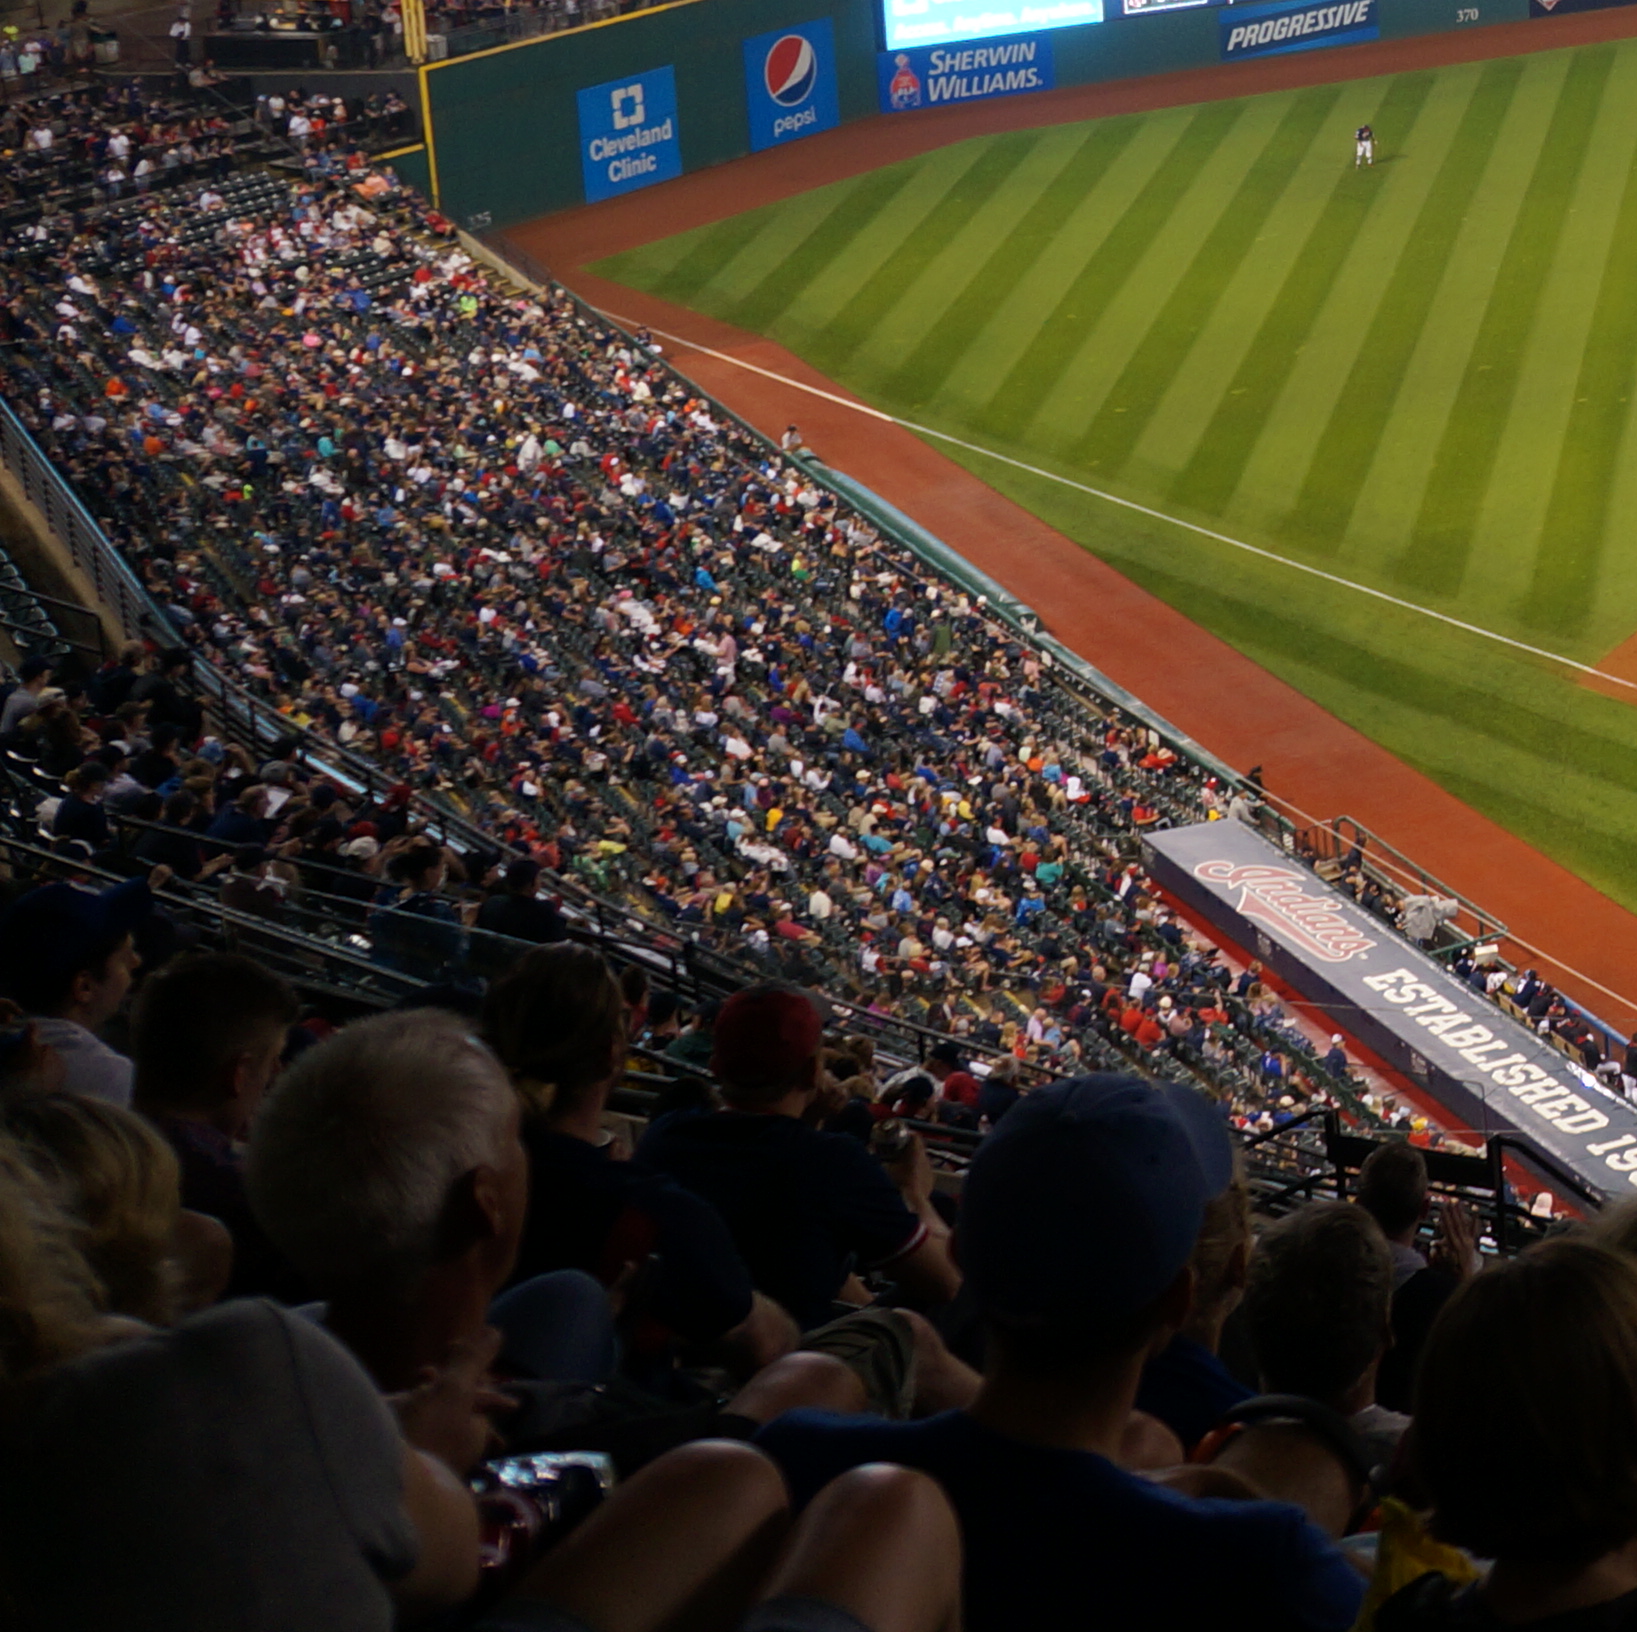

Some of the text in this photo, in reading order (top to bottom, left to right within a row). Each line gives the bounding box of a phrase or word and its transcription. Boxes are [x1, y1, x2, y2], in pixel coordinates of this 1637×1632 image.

[1227, 0, 1371, 51] PROGRESSIVE
[1456, 8, 1479, 24] 370
[928, 42, 1036, 76] SHERWIN
[589, 118, 673, 162] Cleveland
[773, 105, 819, 138] pepsi
[608, 152, 657, 183] Clinic
[1194, 860, 1377, 963] Indians
[1362, 968, 1610, 1135] ESTABLISHED
